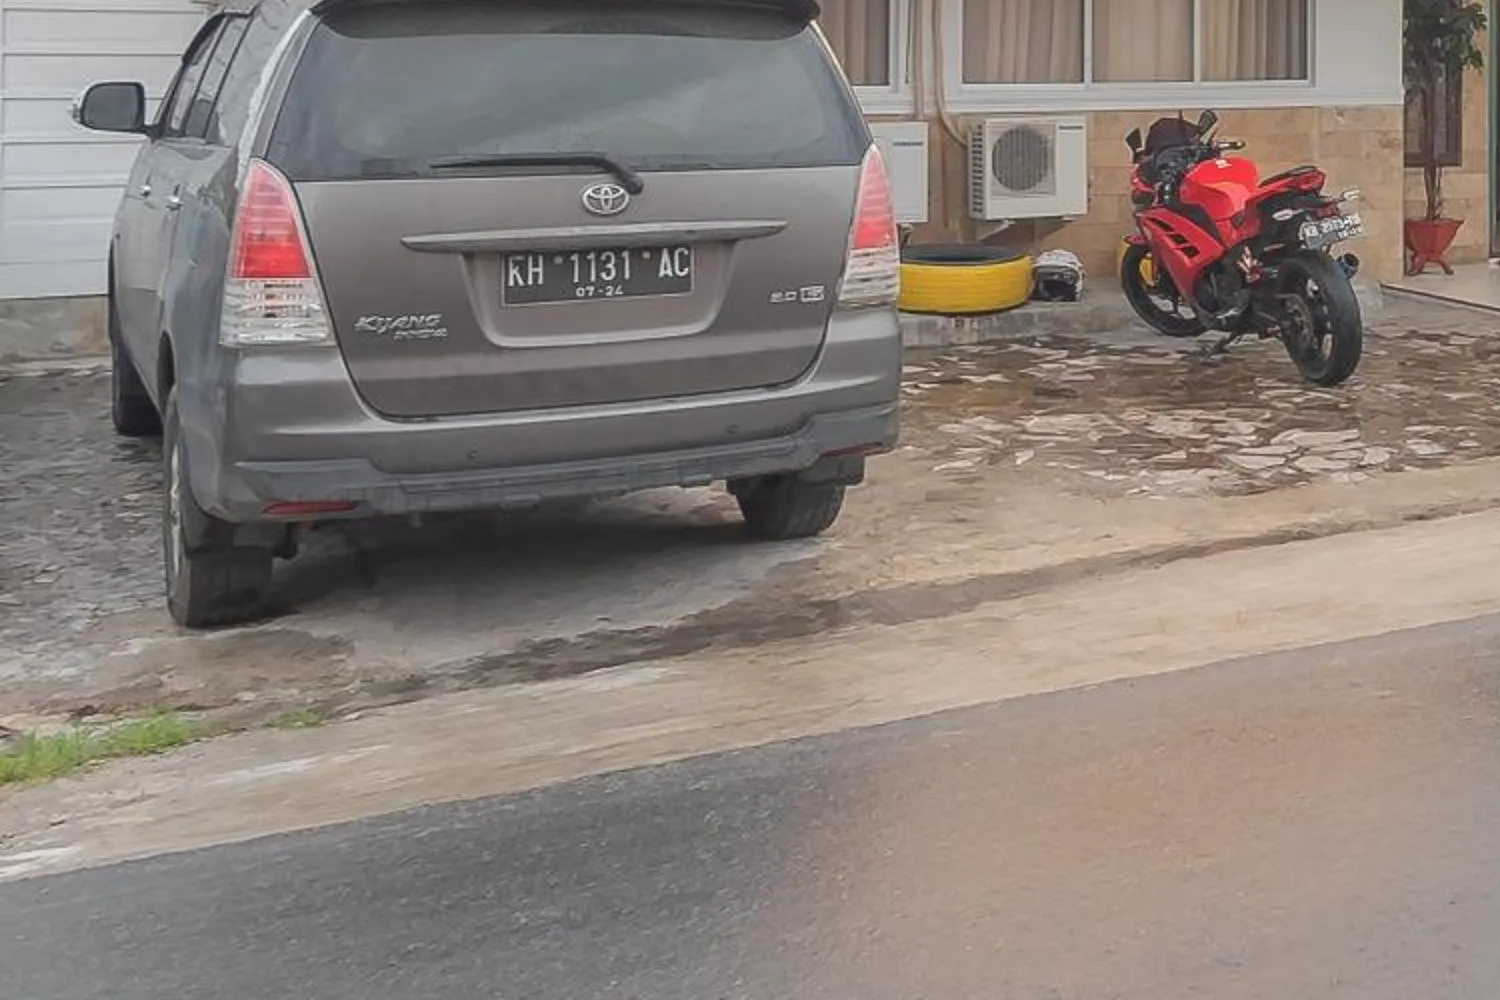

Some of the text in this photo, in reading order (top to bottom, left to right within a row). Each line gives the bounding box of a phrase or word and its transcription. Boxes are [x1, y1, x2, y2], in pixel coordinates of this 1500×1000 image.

[508, 247, 690, 287] KH 1131 AC
[574, 285, 625, 298] 07-24
